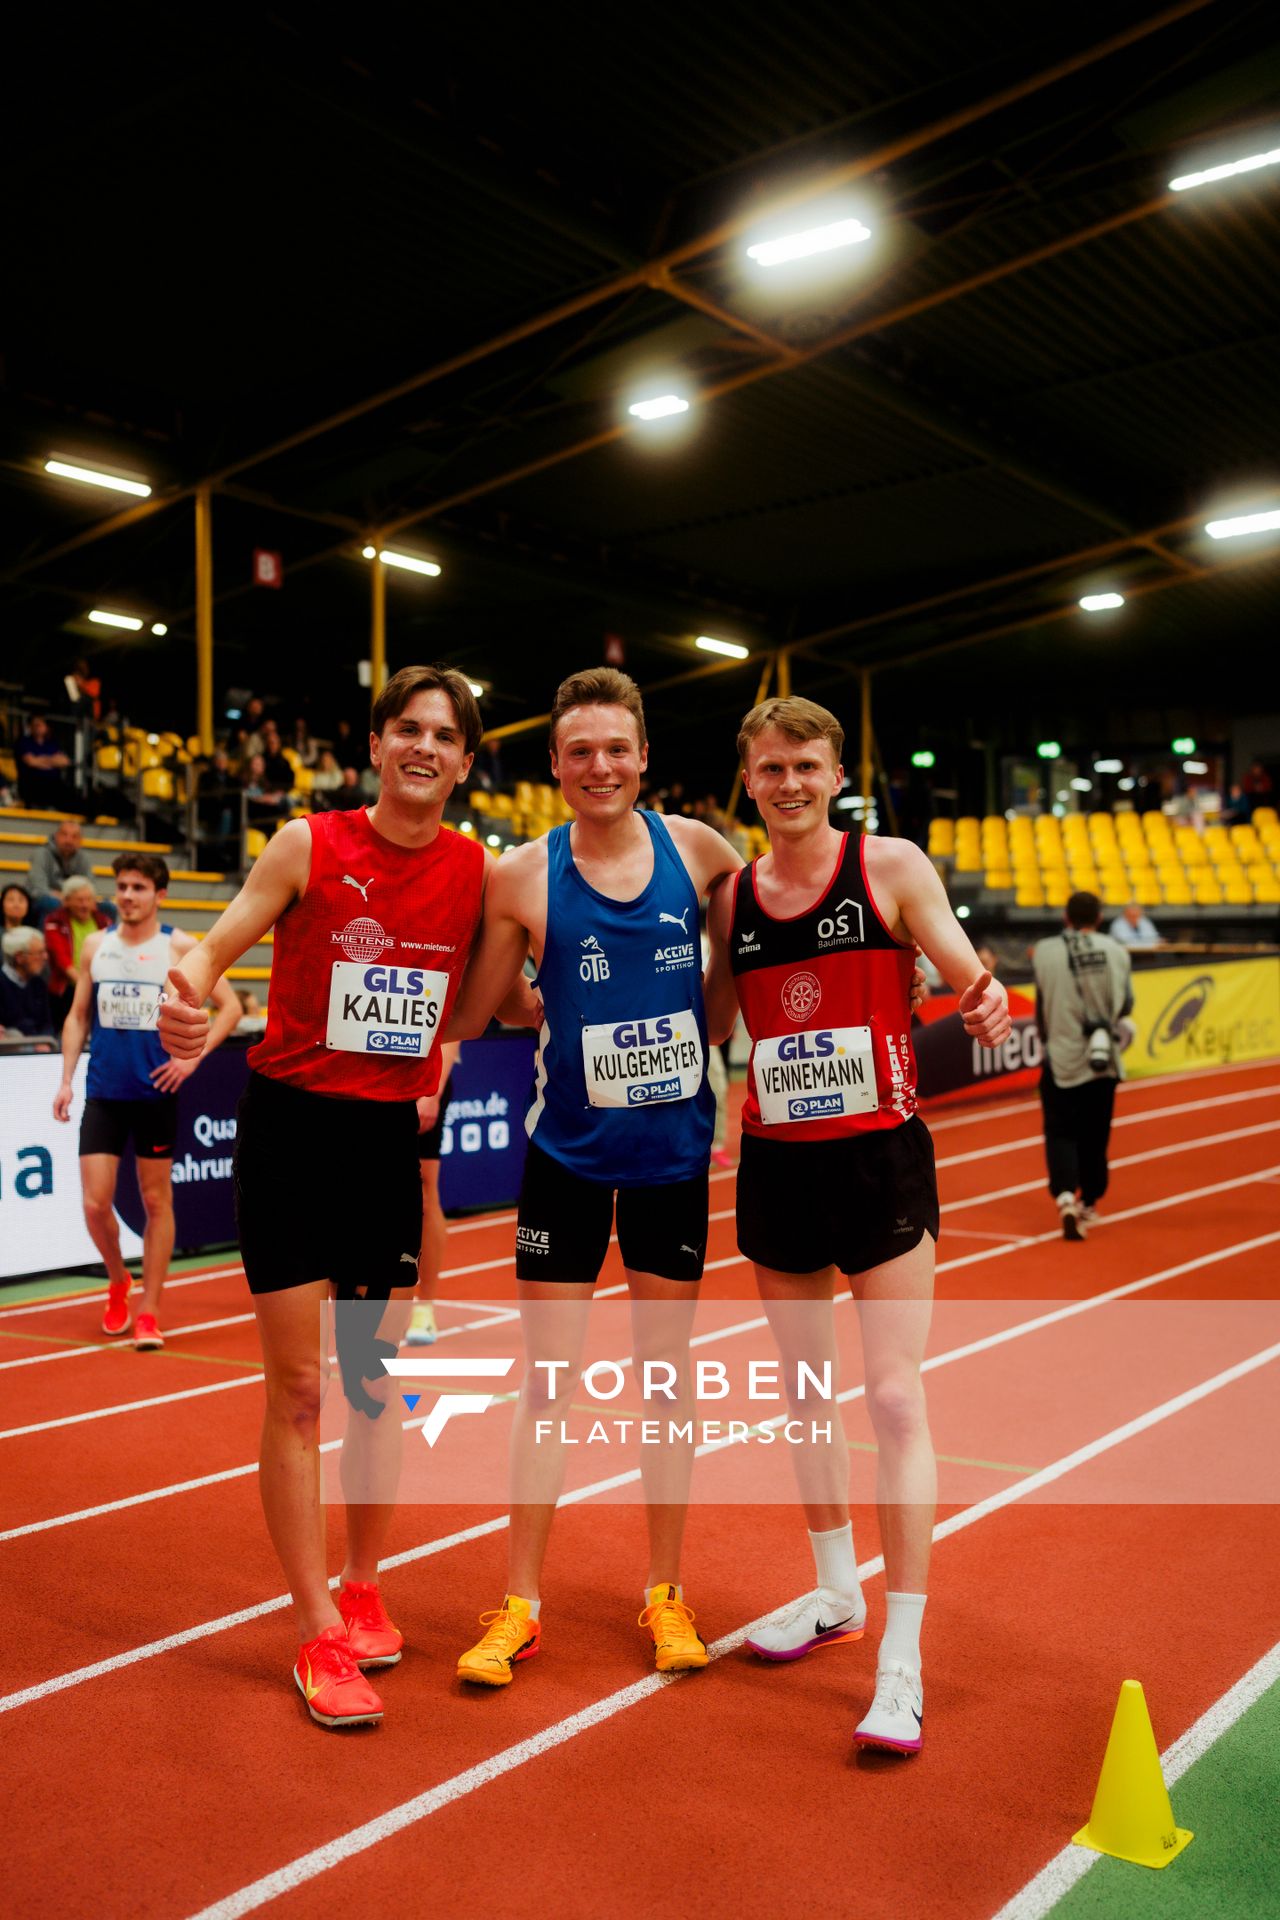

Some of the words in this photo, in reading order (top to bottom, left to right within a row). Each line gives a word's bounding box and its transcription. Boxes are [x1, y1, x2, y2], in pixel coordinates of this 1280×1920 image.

[258, 554, 276, 581] B
[331, 933, 394, 947] MIETENS
[400, 941, 457, 953] www.mietens.d
[738, 943, 761, 955] erima
[579, 953, 611, 982] OTB
[342, 993, 438, 1028] KALIES
[390, 1036, 419, 1046] PLAN
[593, 1040, 699, 1082] KULGEMEYER
[762, 1057, 865, 1094] VENNEMANN
[650, 1081, 679, 1095] PLAN
[810, 1097, 842, 1110] PLAN
